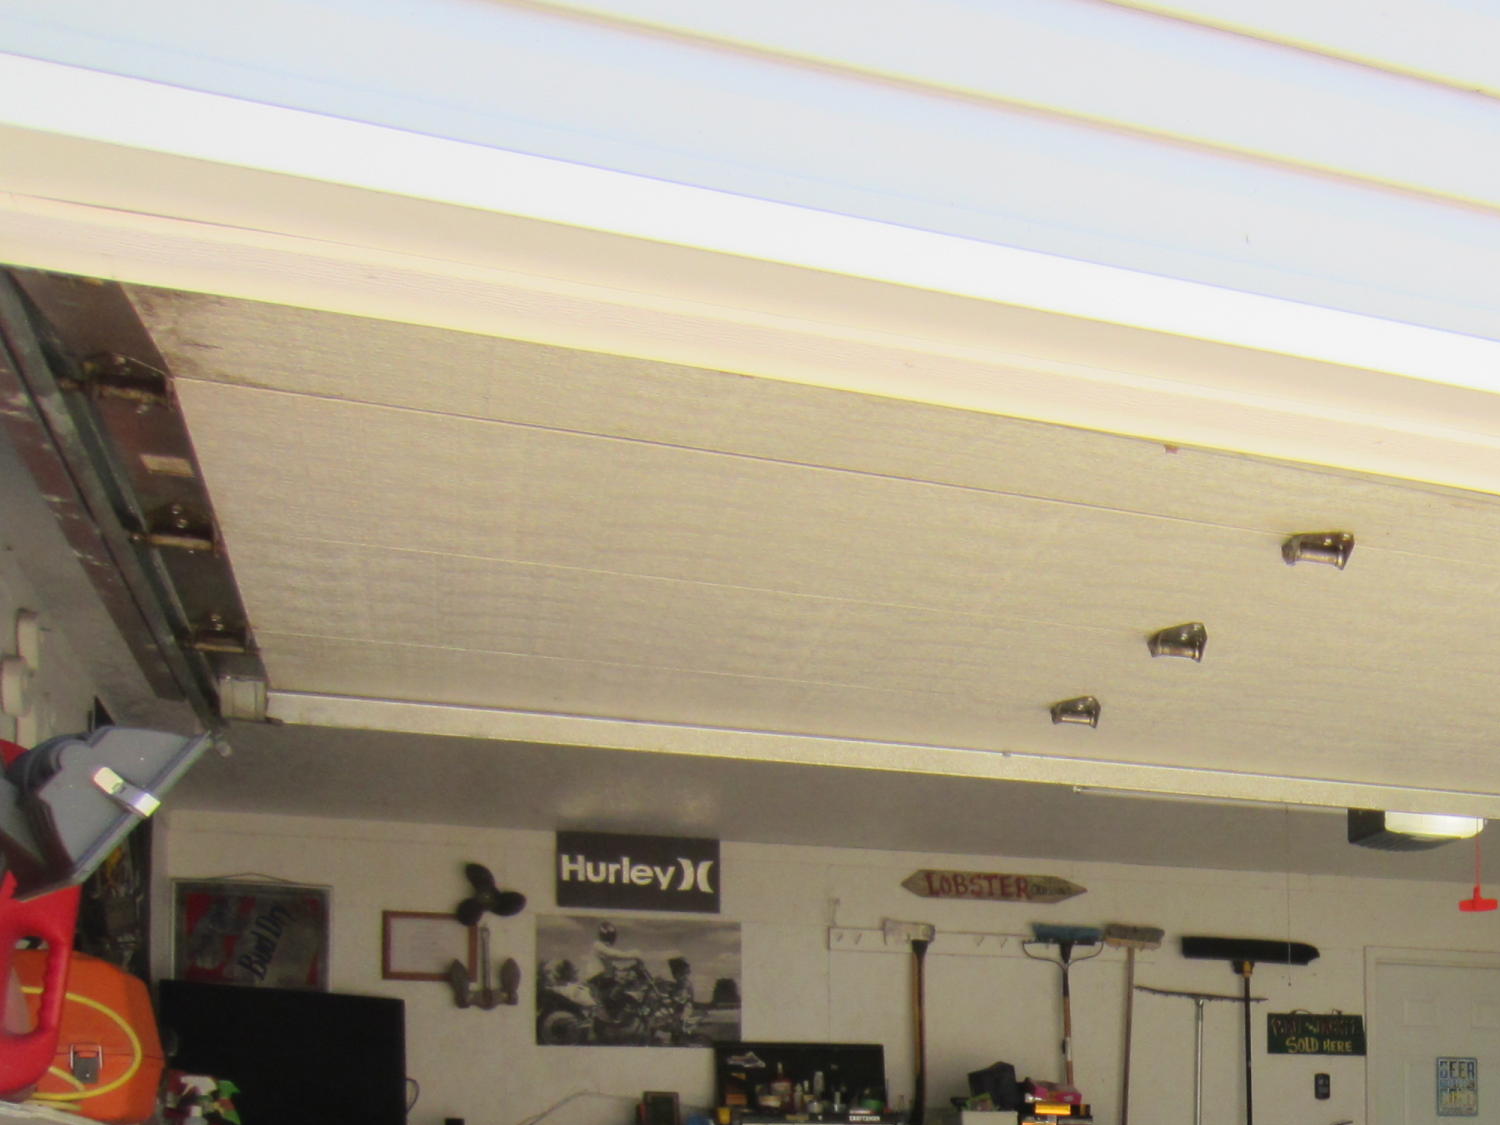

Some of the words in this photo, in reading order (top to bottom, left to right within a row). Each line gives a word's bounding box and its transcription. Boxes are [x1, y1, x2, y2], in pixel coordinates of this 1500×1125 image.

[561, 854, 675, 891] Hurley
[925, 871, 1032, 900] LOBSTER
[255, 903, 297, 939] Dry
[238, 930, 277, 981] Bud
[1285, 1036, 1319, 1053] SOLD
[1323, 1038, 1353, 1053] HERE
